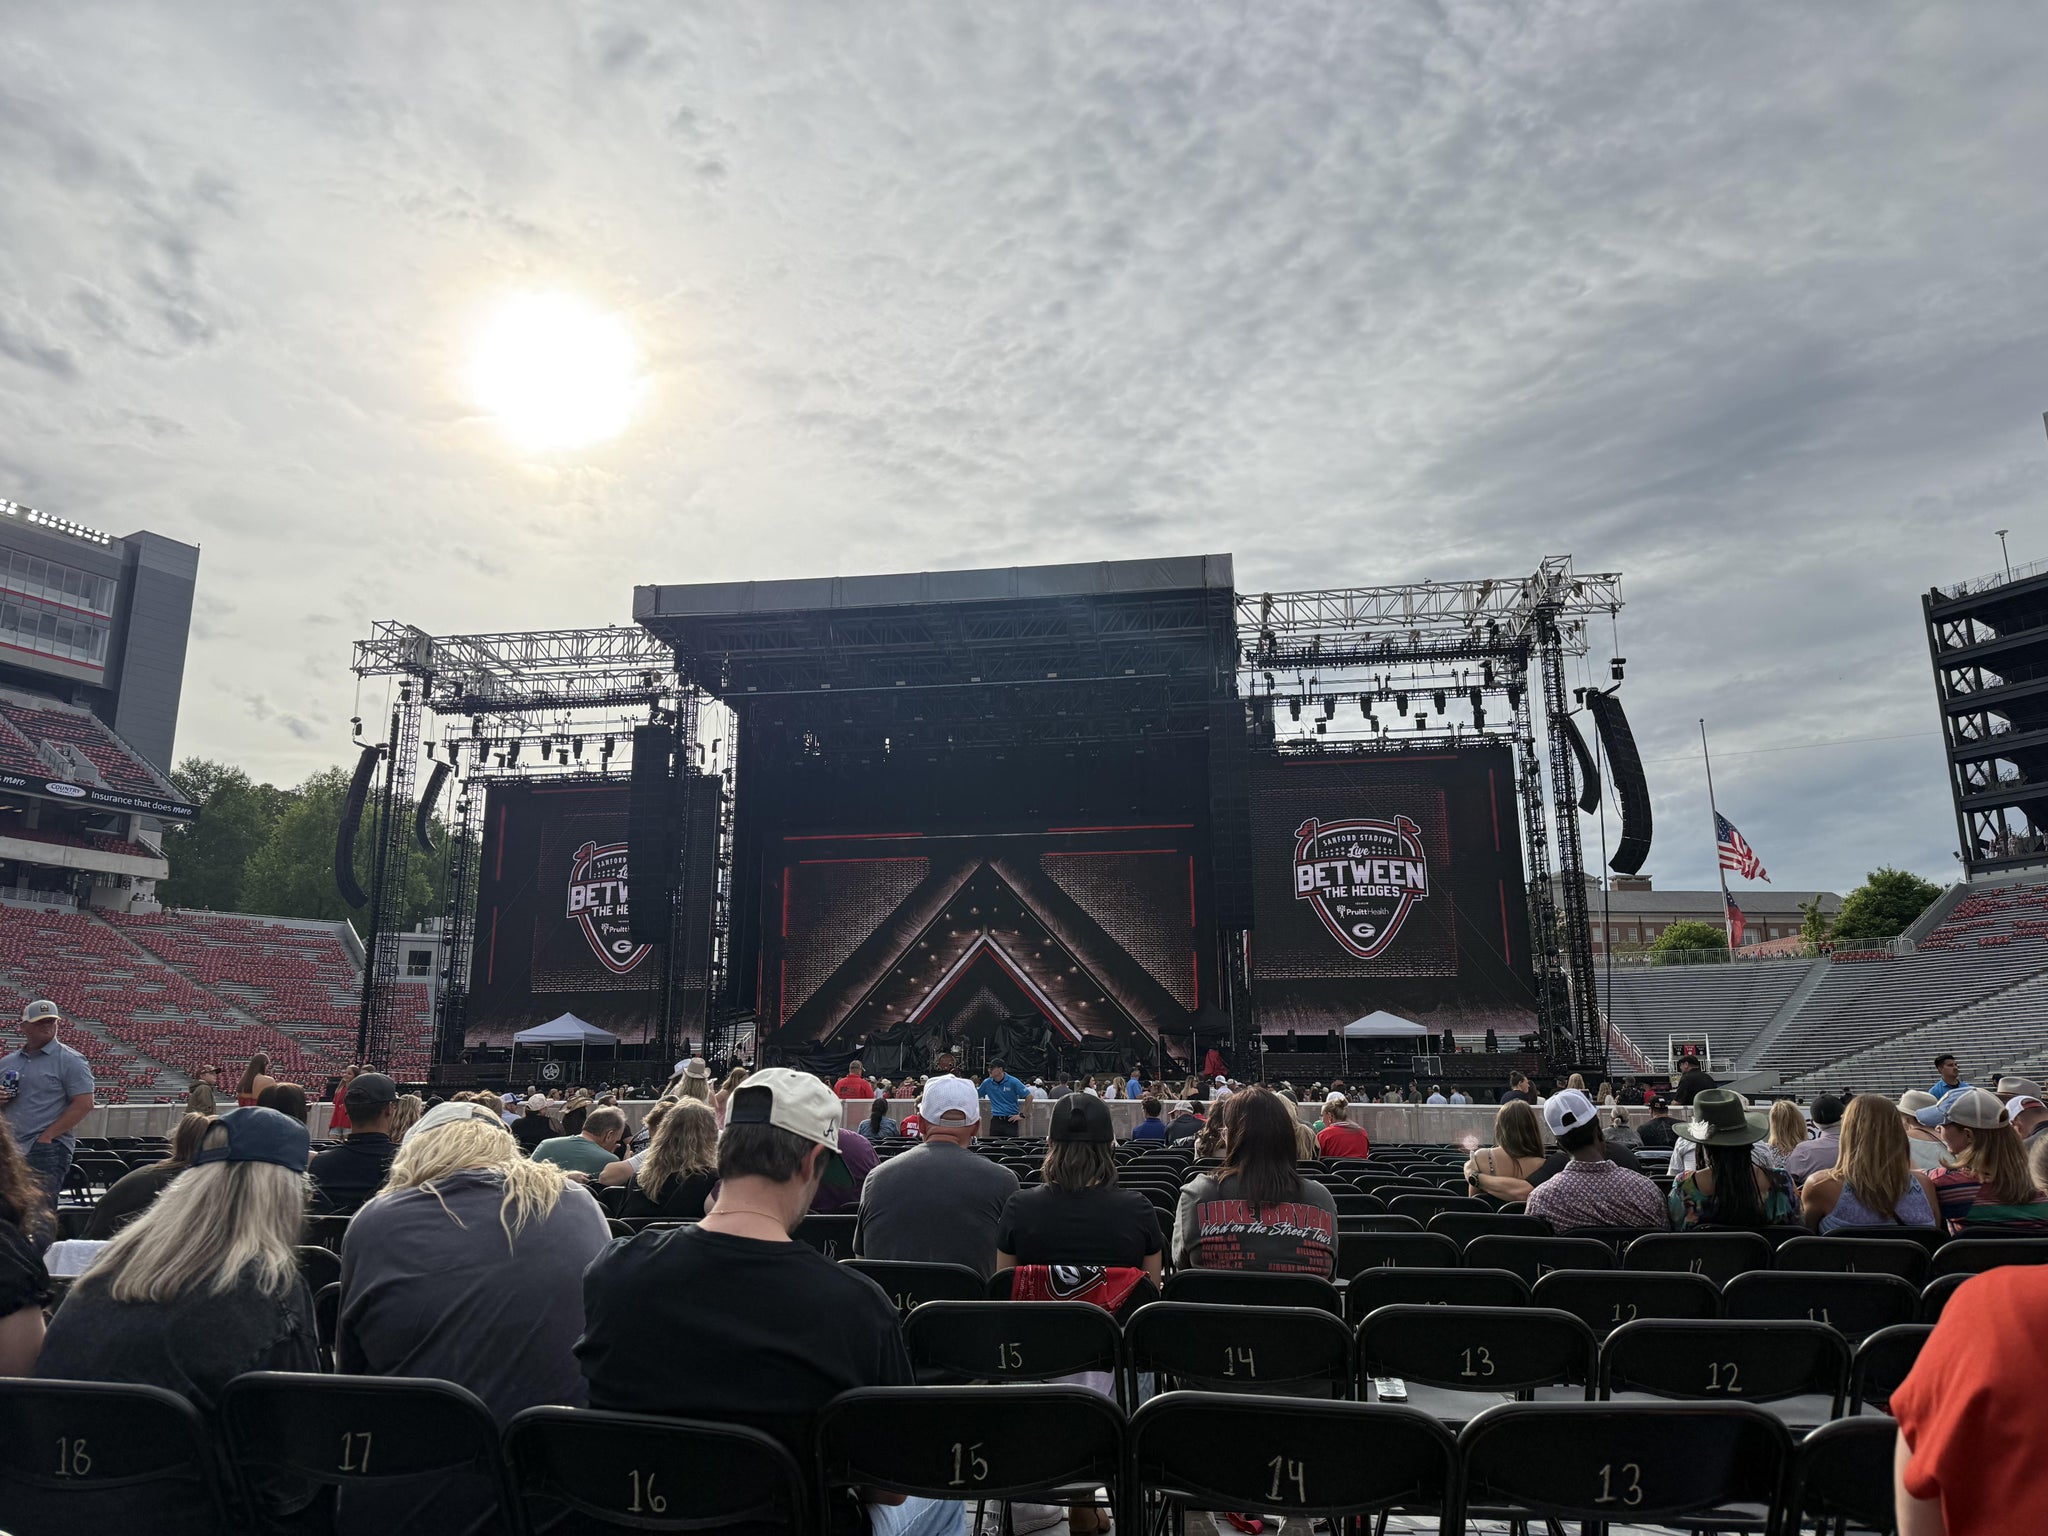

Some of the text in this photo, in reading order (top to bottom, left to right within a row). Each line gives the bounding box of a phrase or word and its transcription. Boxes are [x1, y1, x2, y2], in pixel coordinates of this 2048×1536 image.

[3, 776, 26, 786] more
[51, 784, 81, 794] COUNTRY
[91, 791, 192, 816] Insurance that does more
[1322, 834, 1394, 846] SANFORD STADIUM
[1348, 842, 1370, 858] Live
[596, 857, 627, 868] SANFORD
[1297, 860, 1424, 892] BETWEEN
[1323, 886, 1400, 898] THE HEDGES
[592, 905, 614, 917] THE
[1346, 908, 1390, 916] PruittHealth
[1198, 1200, 1332, 1237] LUKE BRYAN
[1200, 1220, 1230, 1236] Word
[1231, 1224, 1244, 1233] on
[1247, 1219, 1268, 1234] the
[1268, 1221, 1309, 1238] Street
[1308, 1228, 1331, 1245] Tour
[894, 1292, 919, 1311] 16
[997, 1342, 1022, 1368] 15
[1223, 1346, 1256, 1377] 14
[1460, 1347, 1494, 1376] 13
[1706, 1362, 1742, 1392] 12
[55, 1437, 91, 1476] 18
[338, 1432, 372, 1472] 17
[948, 1442, 988, 1485] 15
[627, 1470, 667, 1512] 16
[1265, 1455, 1306, 1503] 14
[1594, 1464, 1642, 1504] 13
